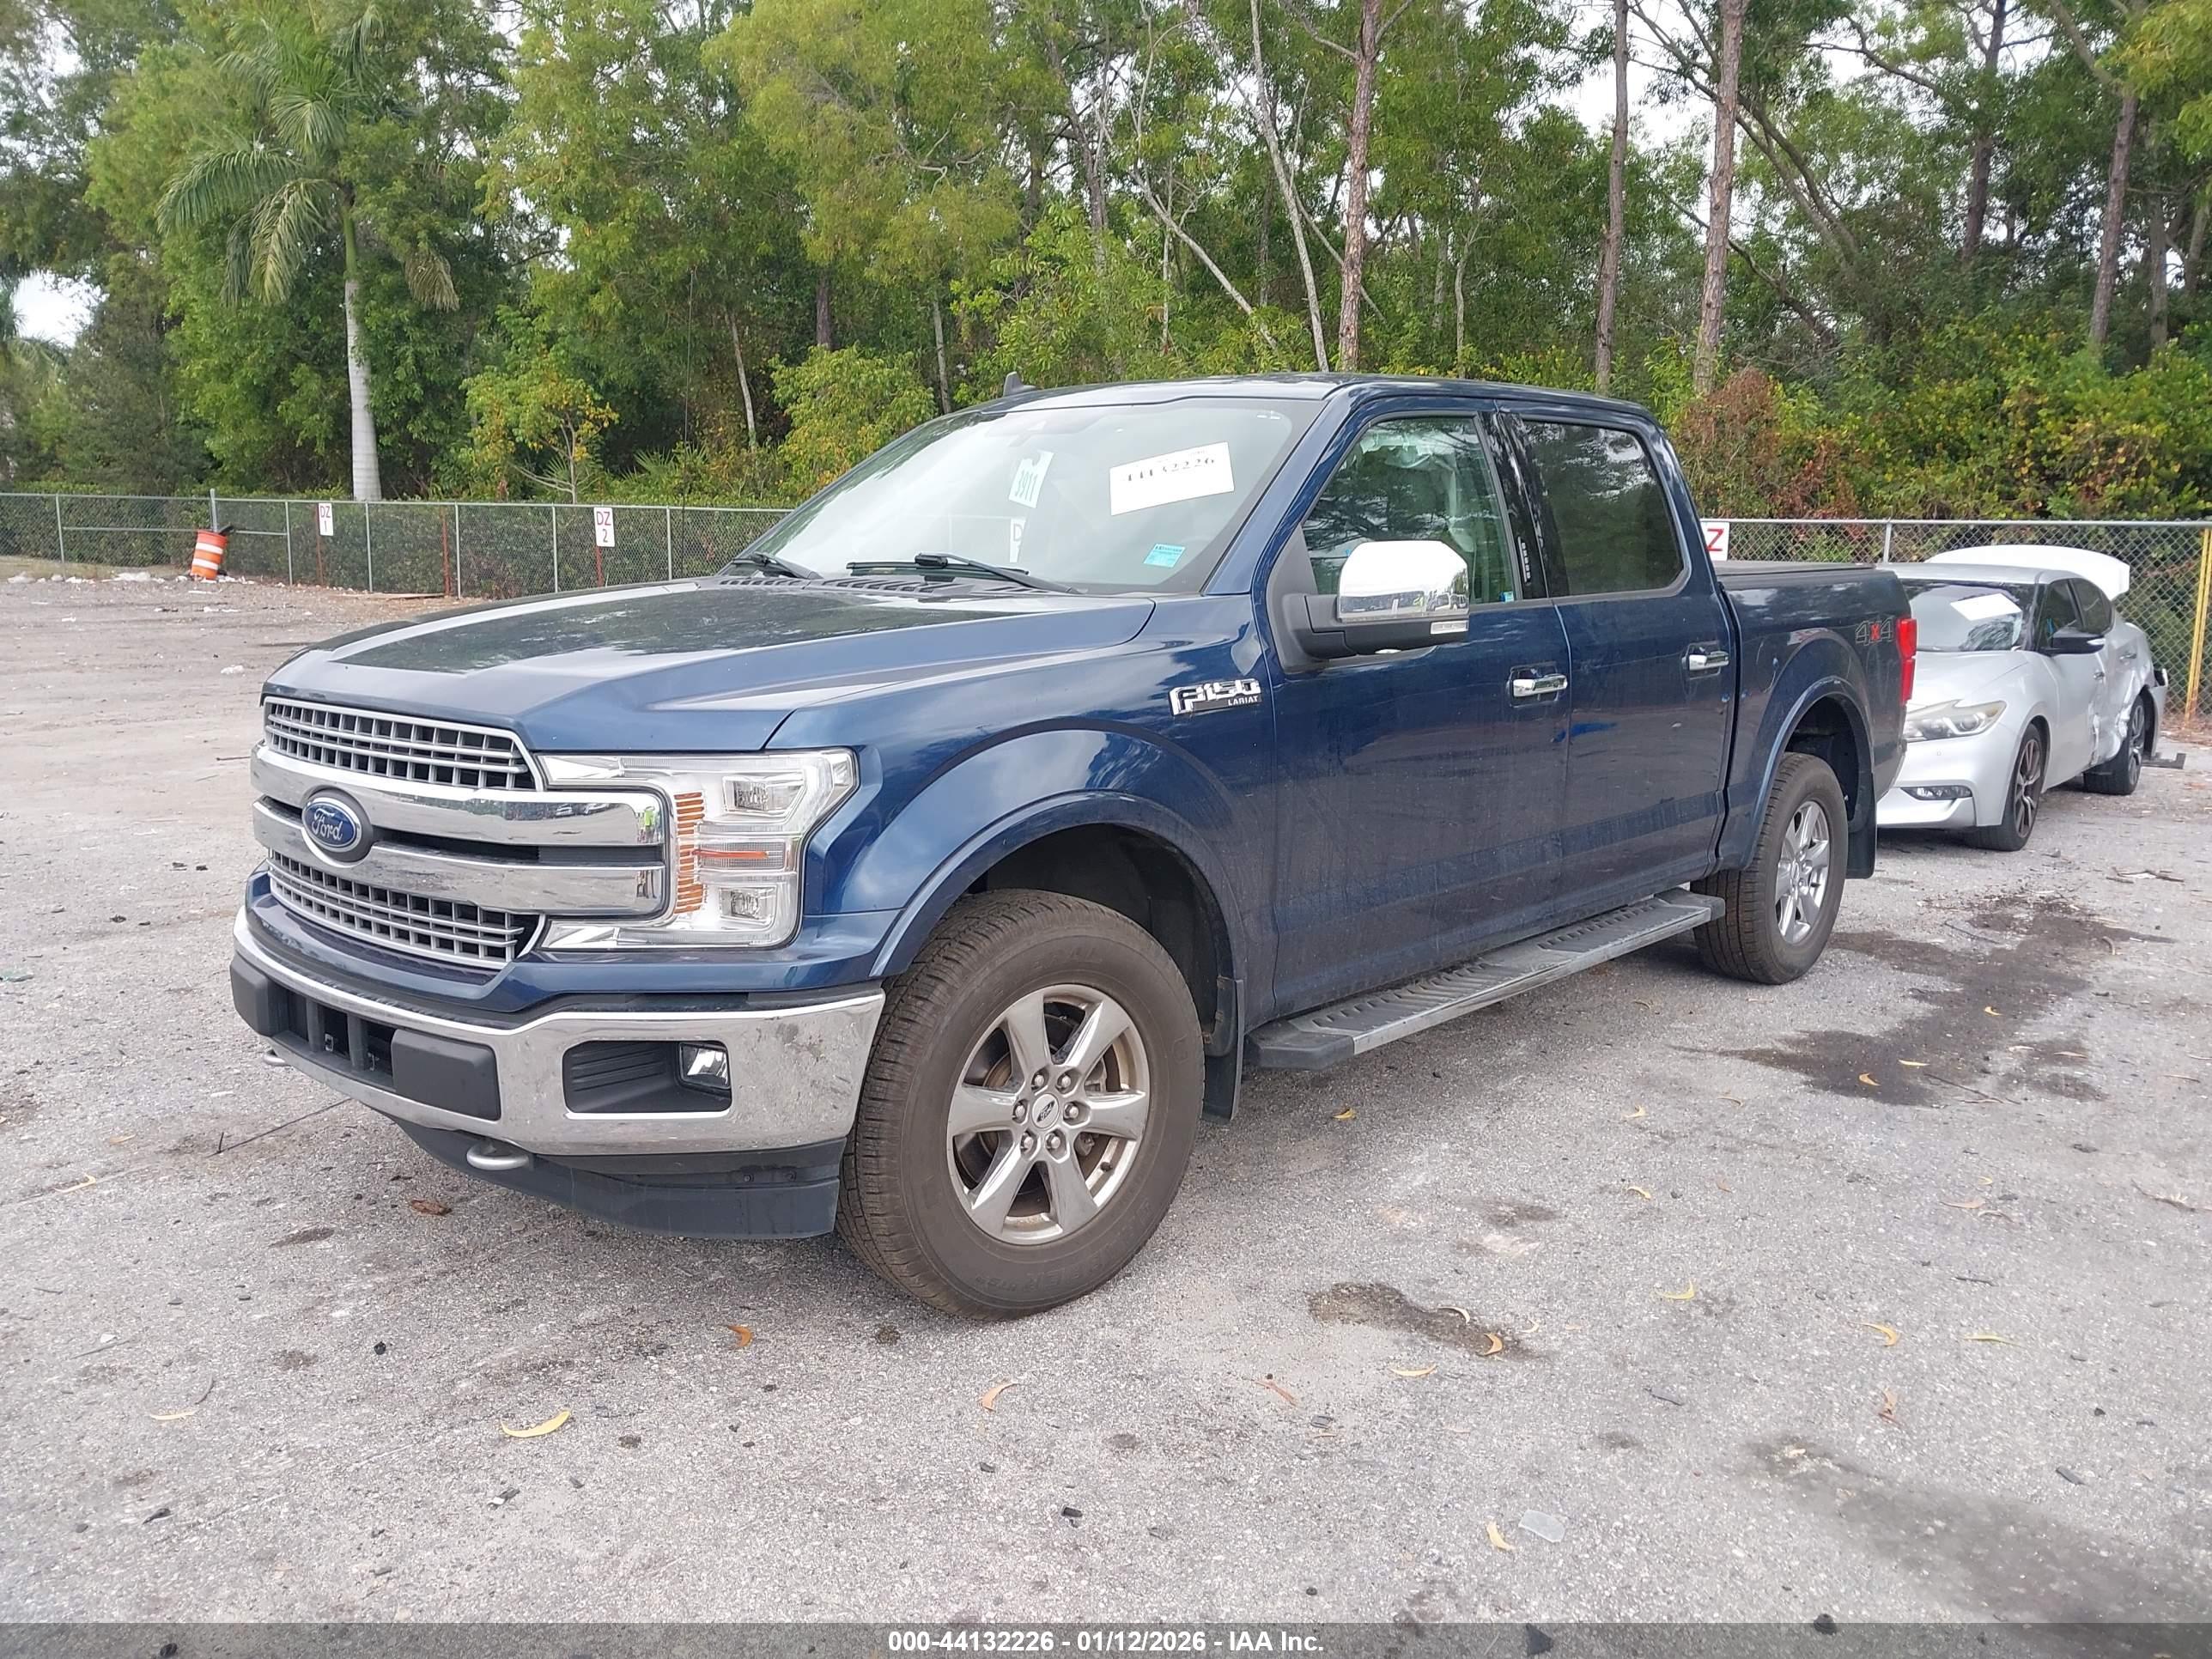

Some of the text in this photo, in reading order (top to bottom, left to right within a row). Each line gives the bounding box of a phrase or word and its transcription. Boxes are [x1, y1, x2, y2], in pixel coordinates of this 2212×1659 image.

[320, 505, 331, 518] DZ
[596, 511, 611, 526] DZ
[602, 528, 609, 543] 2
[1228, 696, 1258, 706] LARIAT
[311, 808, 343, 841] Ford
